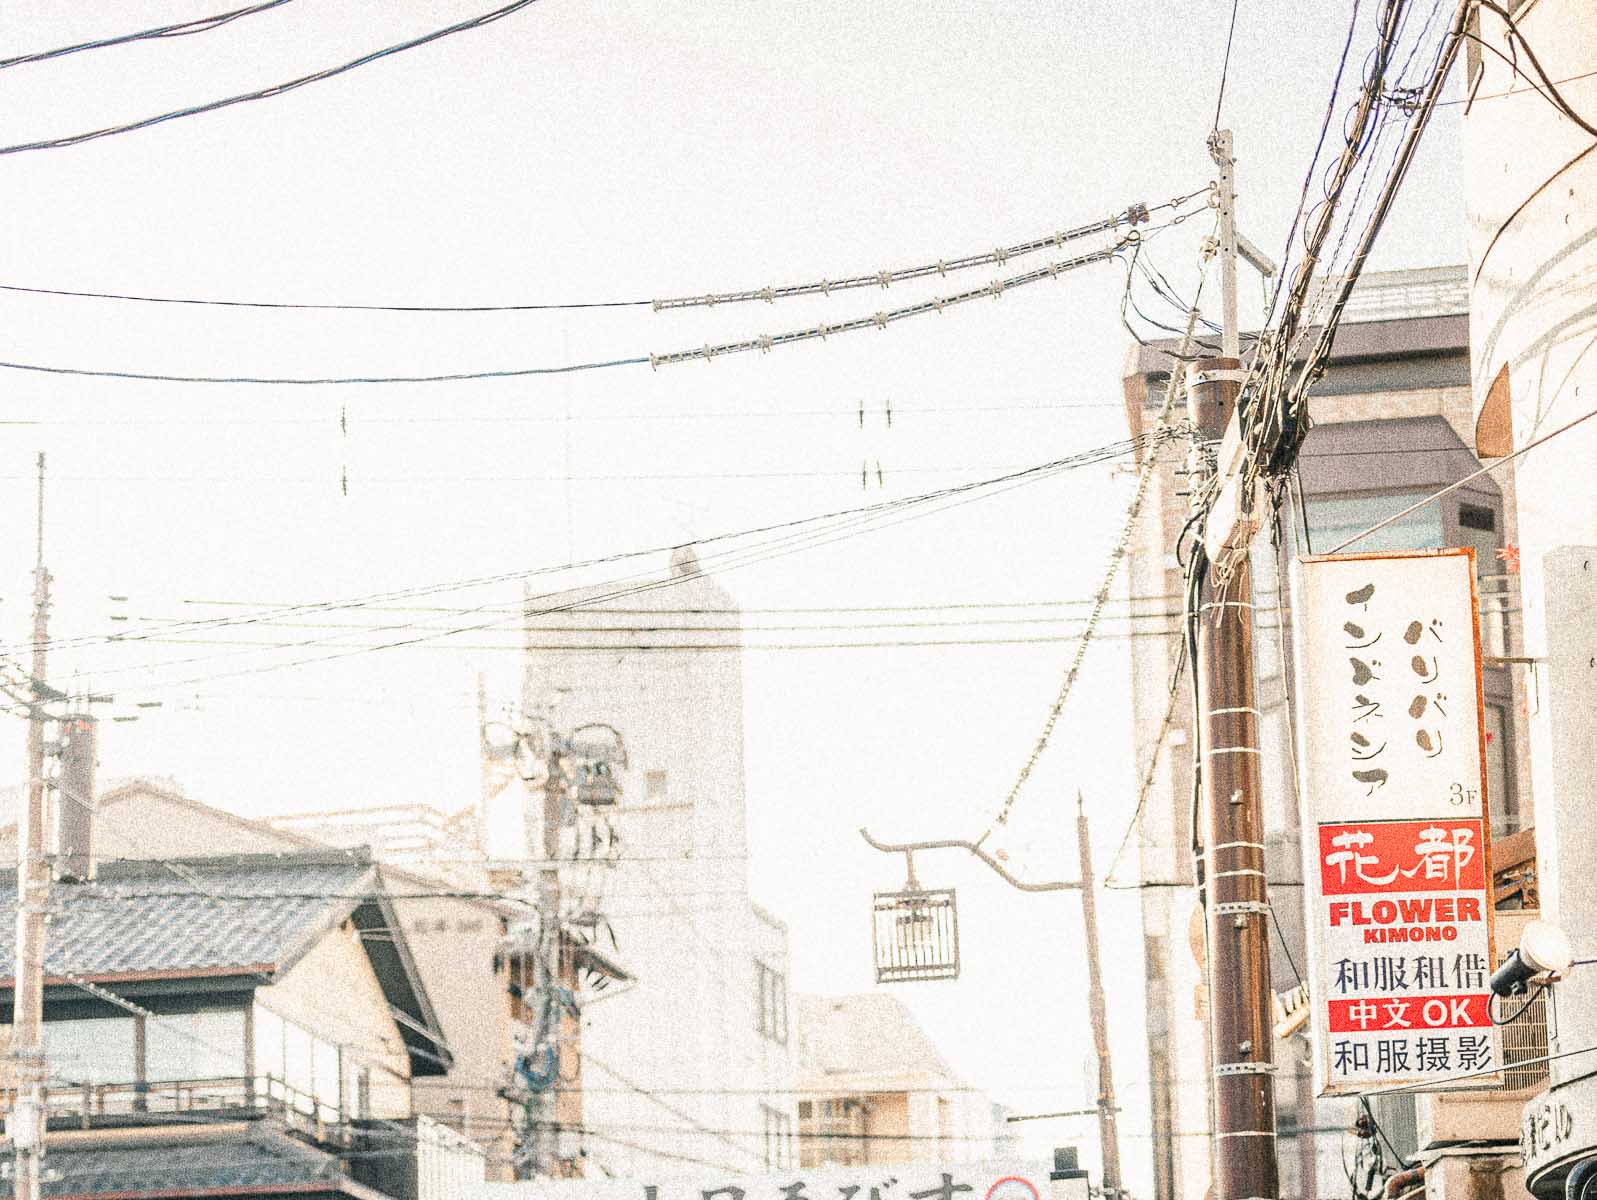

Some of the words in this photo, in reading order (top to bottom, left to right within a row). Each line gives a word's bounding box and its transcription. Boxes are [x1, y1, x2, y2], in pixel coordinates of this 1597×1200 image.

[1403, 617, 1448, 759] バリバリ
[1449, 782, 1478, 806] 3F
[1325, 823, 1477, 890] 花都
[1329, 897, 1482, 927] FLOWER
[1363, 926, 1458, 944] KIMONO
[1333, 953, 1487, 994] 和服租借
[1349, 999, 1413, 1030] 中文
[1422, 997, 1474, 1027] OK
[1334, 1034, 1493, 1076] 和服摄影
